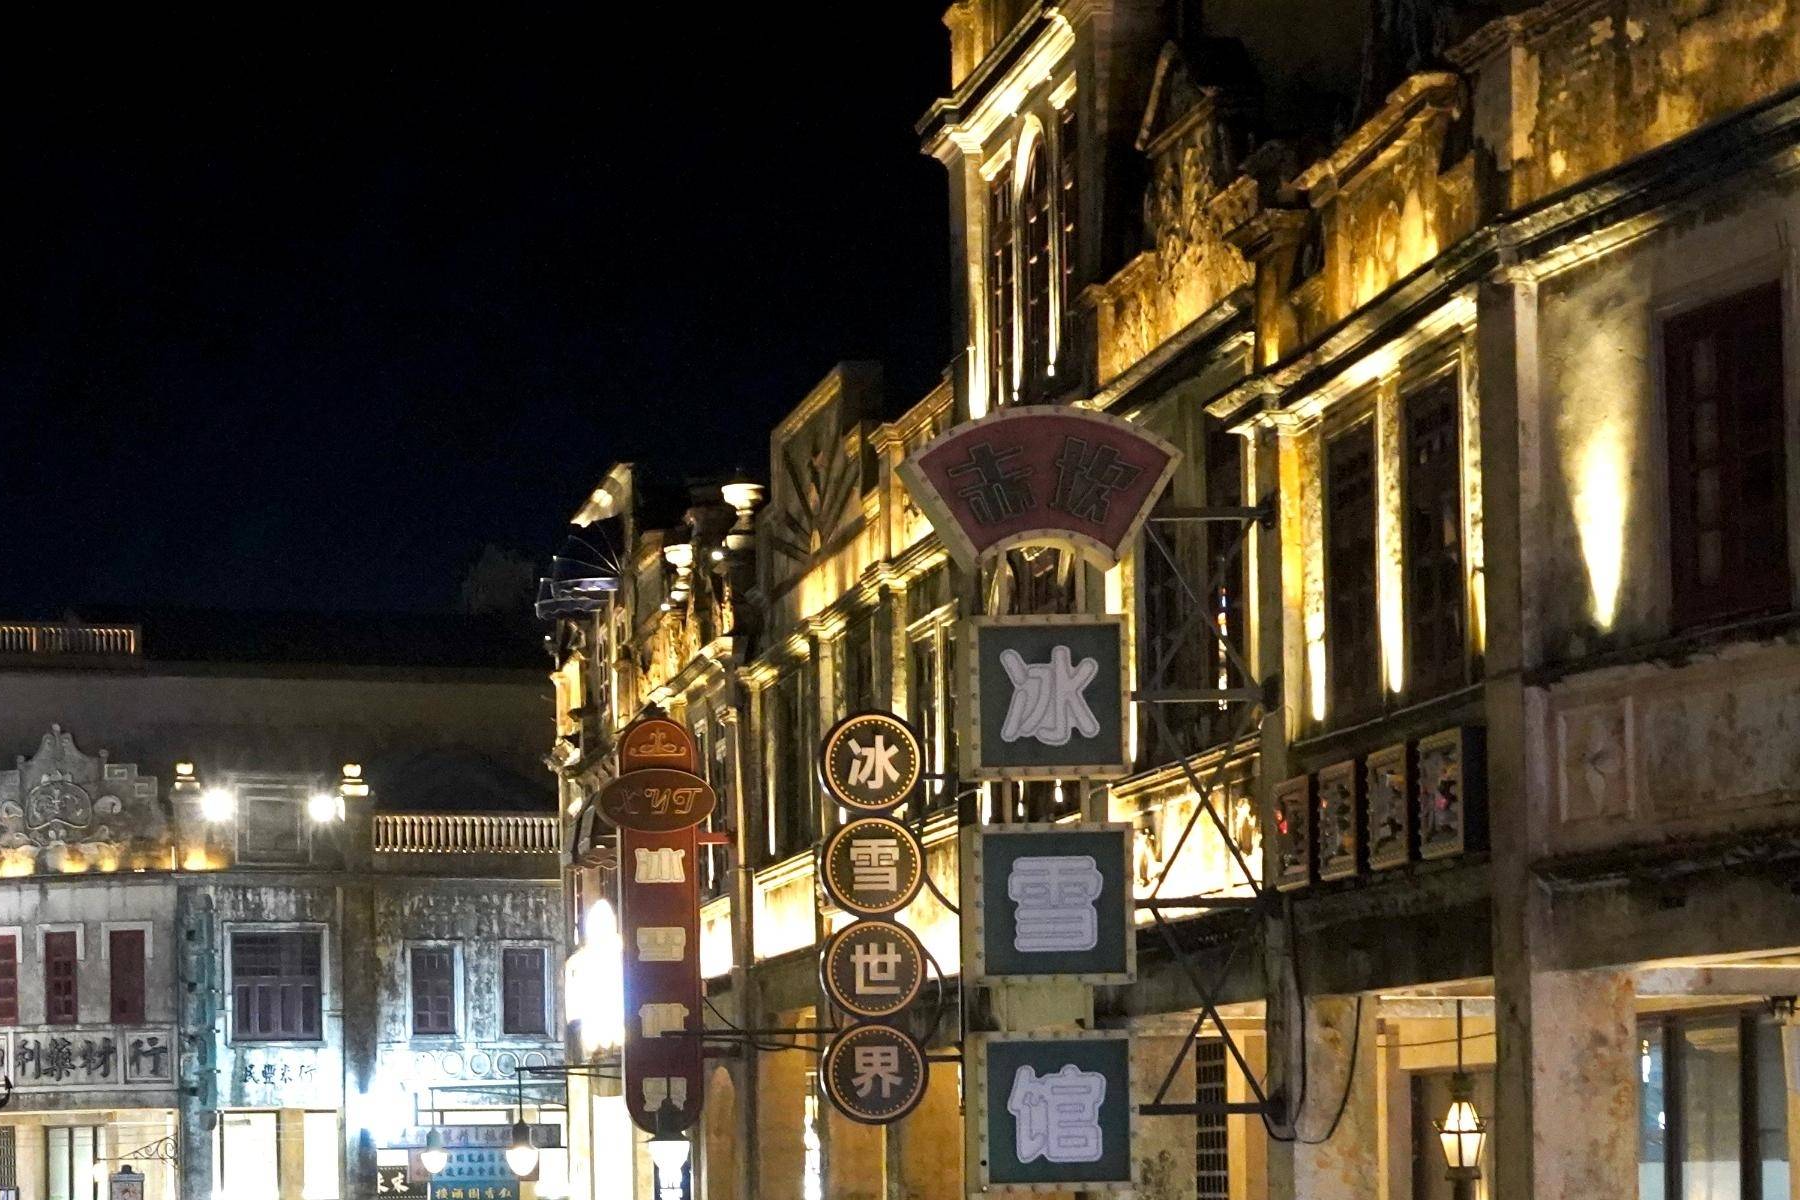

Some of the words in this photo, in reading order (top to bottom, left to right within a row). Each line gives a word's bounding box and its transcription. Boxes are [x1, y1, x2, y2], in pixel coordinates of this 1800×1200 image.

[848, 734, 903, 1099] 冰雪世界
[999, 645, 1107, 1163] 冰雪馆
